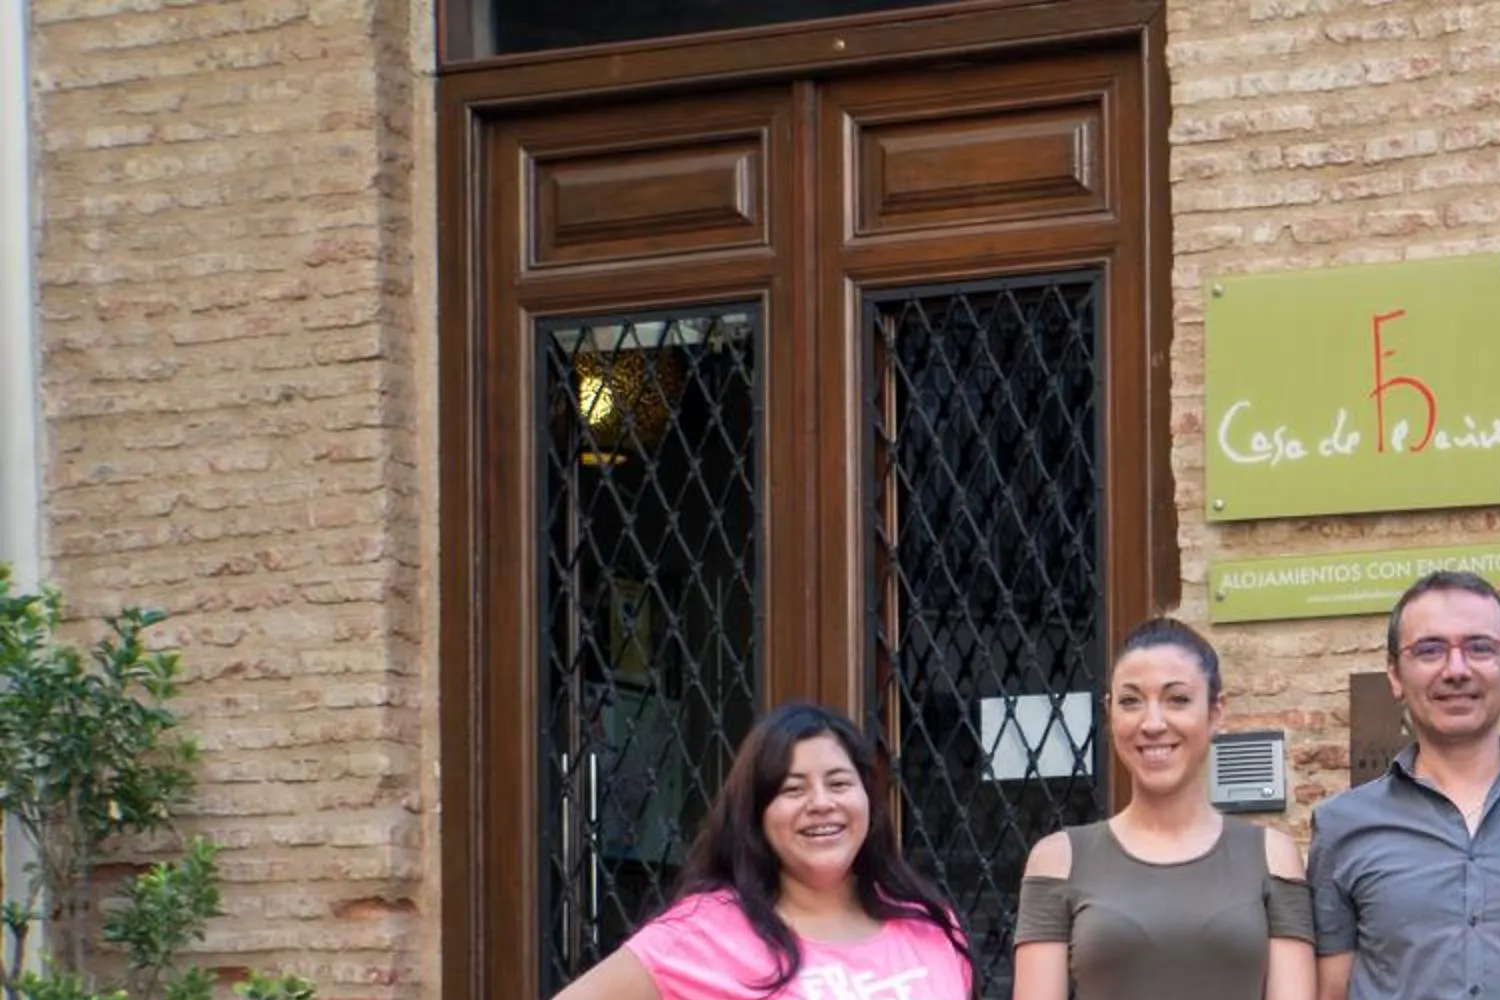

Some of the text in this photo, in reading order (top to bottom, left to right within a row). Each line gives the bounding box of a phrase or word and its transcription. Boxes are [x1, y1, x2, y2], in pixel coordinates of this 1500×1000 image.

[1218, 400, 1307, 466] Casa
[1319, 408, 1361, 457] de
[1222, 563, 1361, 589] ALOJAMIENTOS
[1366, 560, 1411, 580] CON
